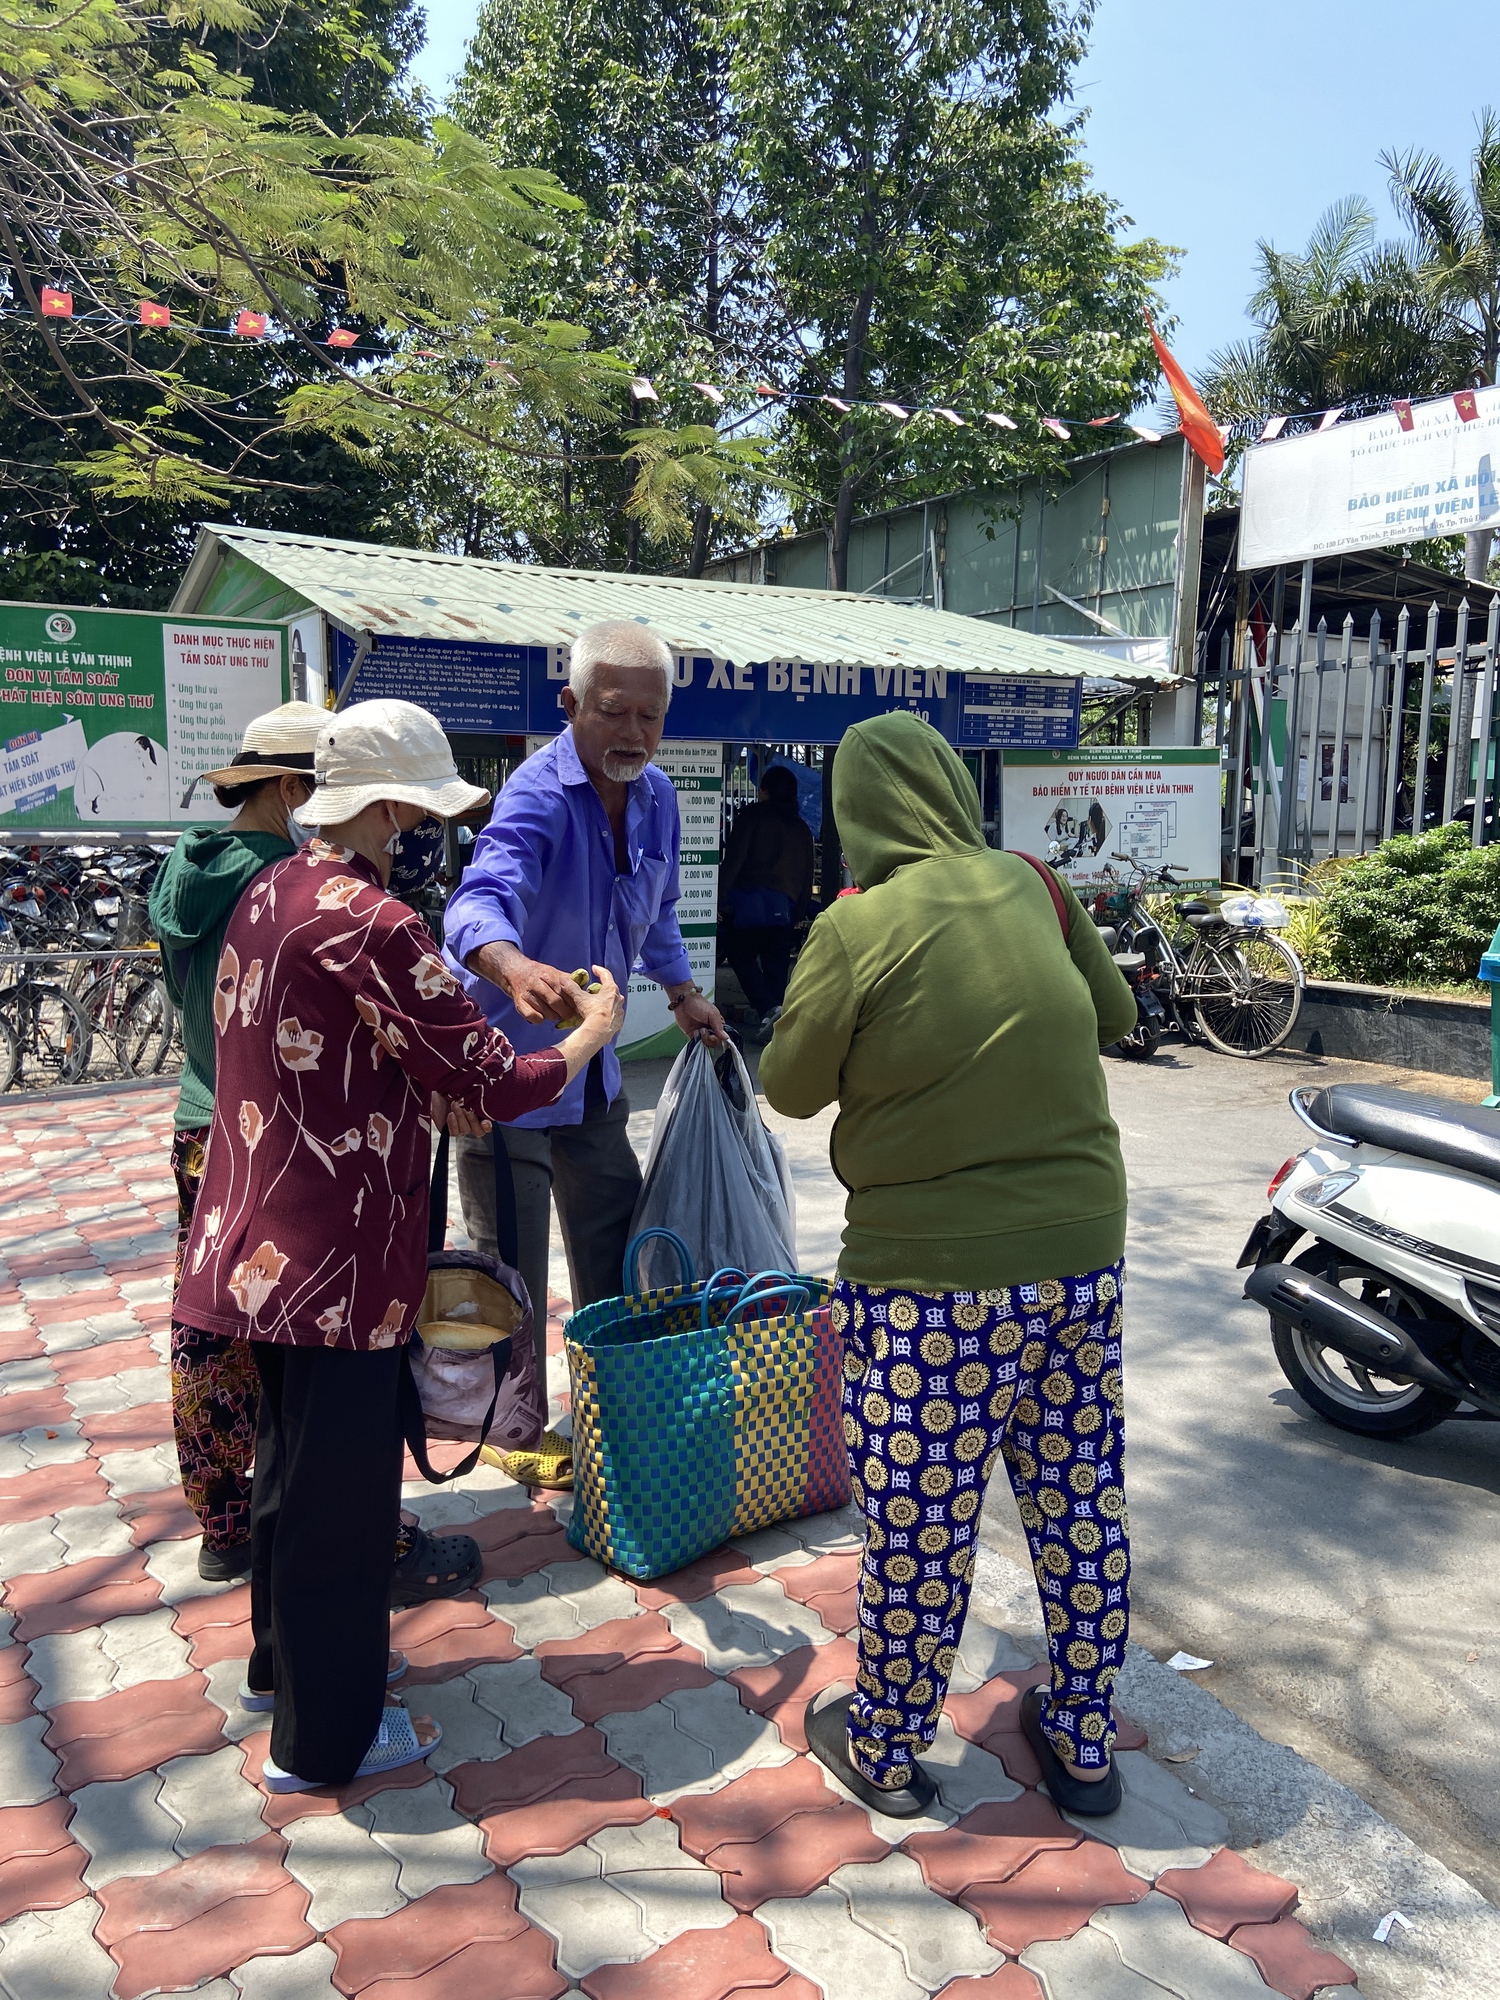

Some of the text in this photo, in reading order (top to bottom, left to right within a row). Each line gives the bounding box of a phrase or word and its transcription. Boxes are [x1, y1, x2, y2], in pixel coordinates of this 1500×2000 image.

[1348, 493, 1380, 511] BẢO
[1385, 482, 1430, 503] HIỂM
[1435, 476, 1459, 494] XÃ
[1385, 489, 1500, 526] BỆNH VIỆN LÊ
[173, 633, 275, 652] DANH MỤC THỰC HIỆN
[25, 649, 52, 665] VIỆN
[55, 650, 69, 664] LÊ
[72, 652, 95, 665] VĂN
[98, 654, 132, 669] THỊNH
[181, 649, 270, 668] TẦM SOÁT UNG THƯ
[5, 667, 119, 687] ĐƠN VỊ TẦM SOÁT
[706, 658, 754, 691] XE
[178, 684, 218, 695] Ung thư vú
[31, 687, 62, 707] HIỆN
[66, 689, 95, 706] SỚM
[99, 693, 125, 707] UNG
[128, 694, 155, 709] THƯ
[179, 699, 223, 711] Ung thư gan
[180, 714, 194, 726] Ung
[196, 715, 208, 724] thư
[9, 731, 38, 750] ĐƠN VỊ
[180, 730, 195, 741] Ung
[197, 731, 209, 740] thư
[181, 745, 195, 757] Ung
[198, 746, 209, 755] thư
[700, 748, 717, 756] TP.HCM
[20, 750, 40, 768] SOÁT
[681, 764, 715, 774] GIÁ THU
[1068, 767, 1162, 782] QUÝ NGƯỜI DÂN CẦN MUA
[9, 777, 27, 794] HIỆN
[45, 765, 61, 780] UNG
[60, 757, 76, 774] THƯ
[674, 778, 701, 790] ĐIỆN)
[1032, 782, 1194, 797] BẢO HIỂM Y TẾ TẠI BỆNH VIỆN LÊ VĂN THỊNH
[703, 796, 716, 805] VNĐ
[685, 815, 715, 824] 6.000 VNĐ
[702, 836, 714, 845] VNĐ
[1073, 861, 1078, 869] C
[684, 870, 713, 879] 2.000 VNĐ
[684, 889, 713, 899] 4.000 VNĐ
[677, 909, 712, 919] 100.000 VNĐ
[699, 941, 711, 951] VNĐ
[698, 960, 710, 970] VNĐ
[636, 983, 657, 993] 0916
